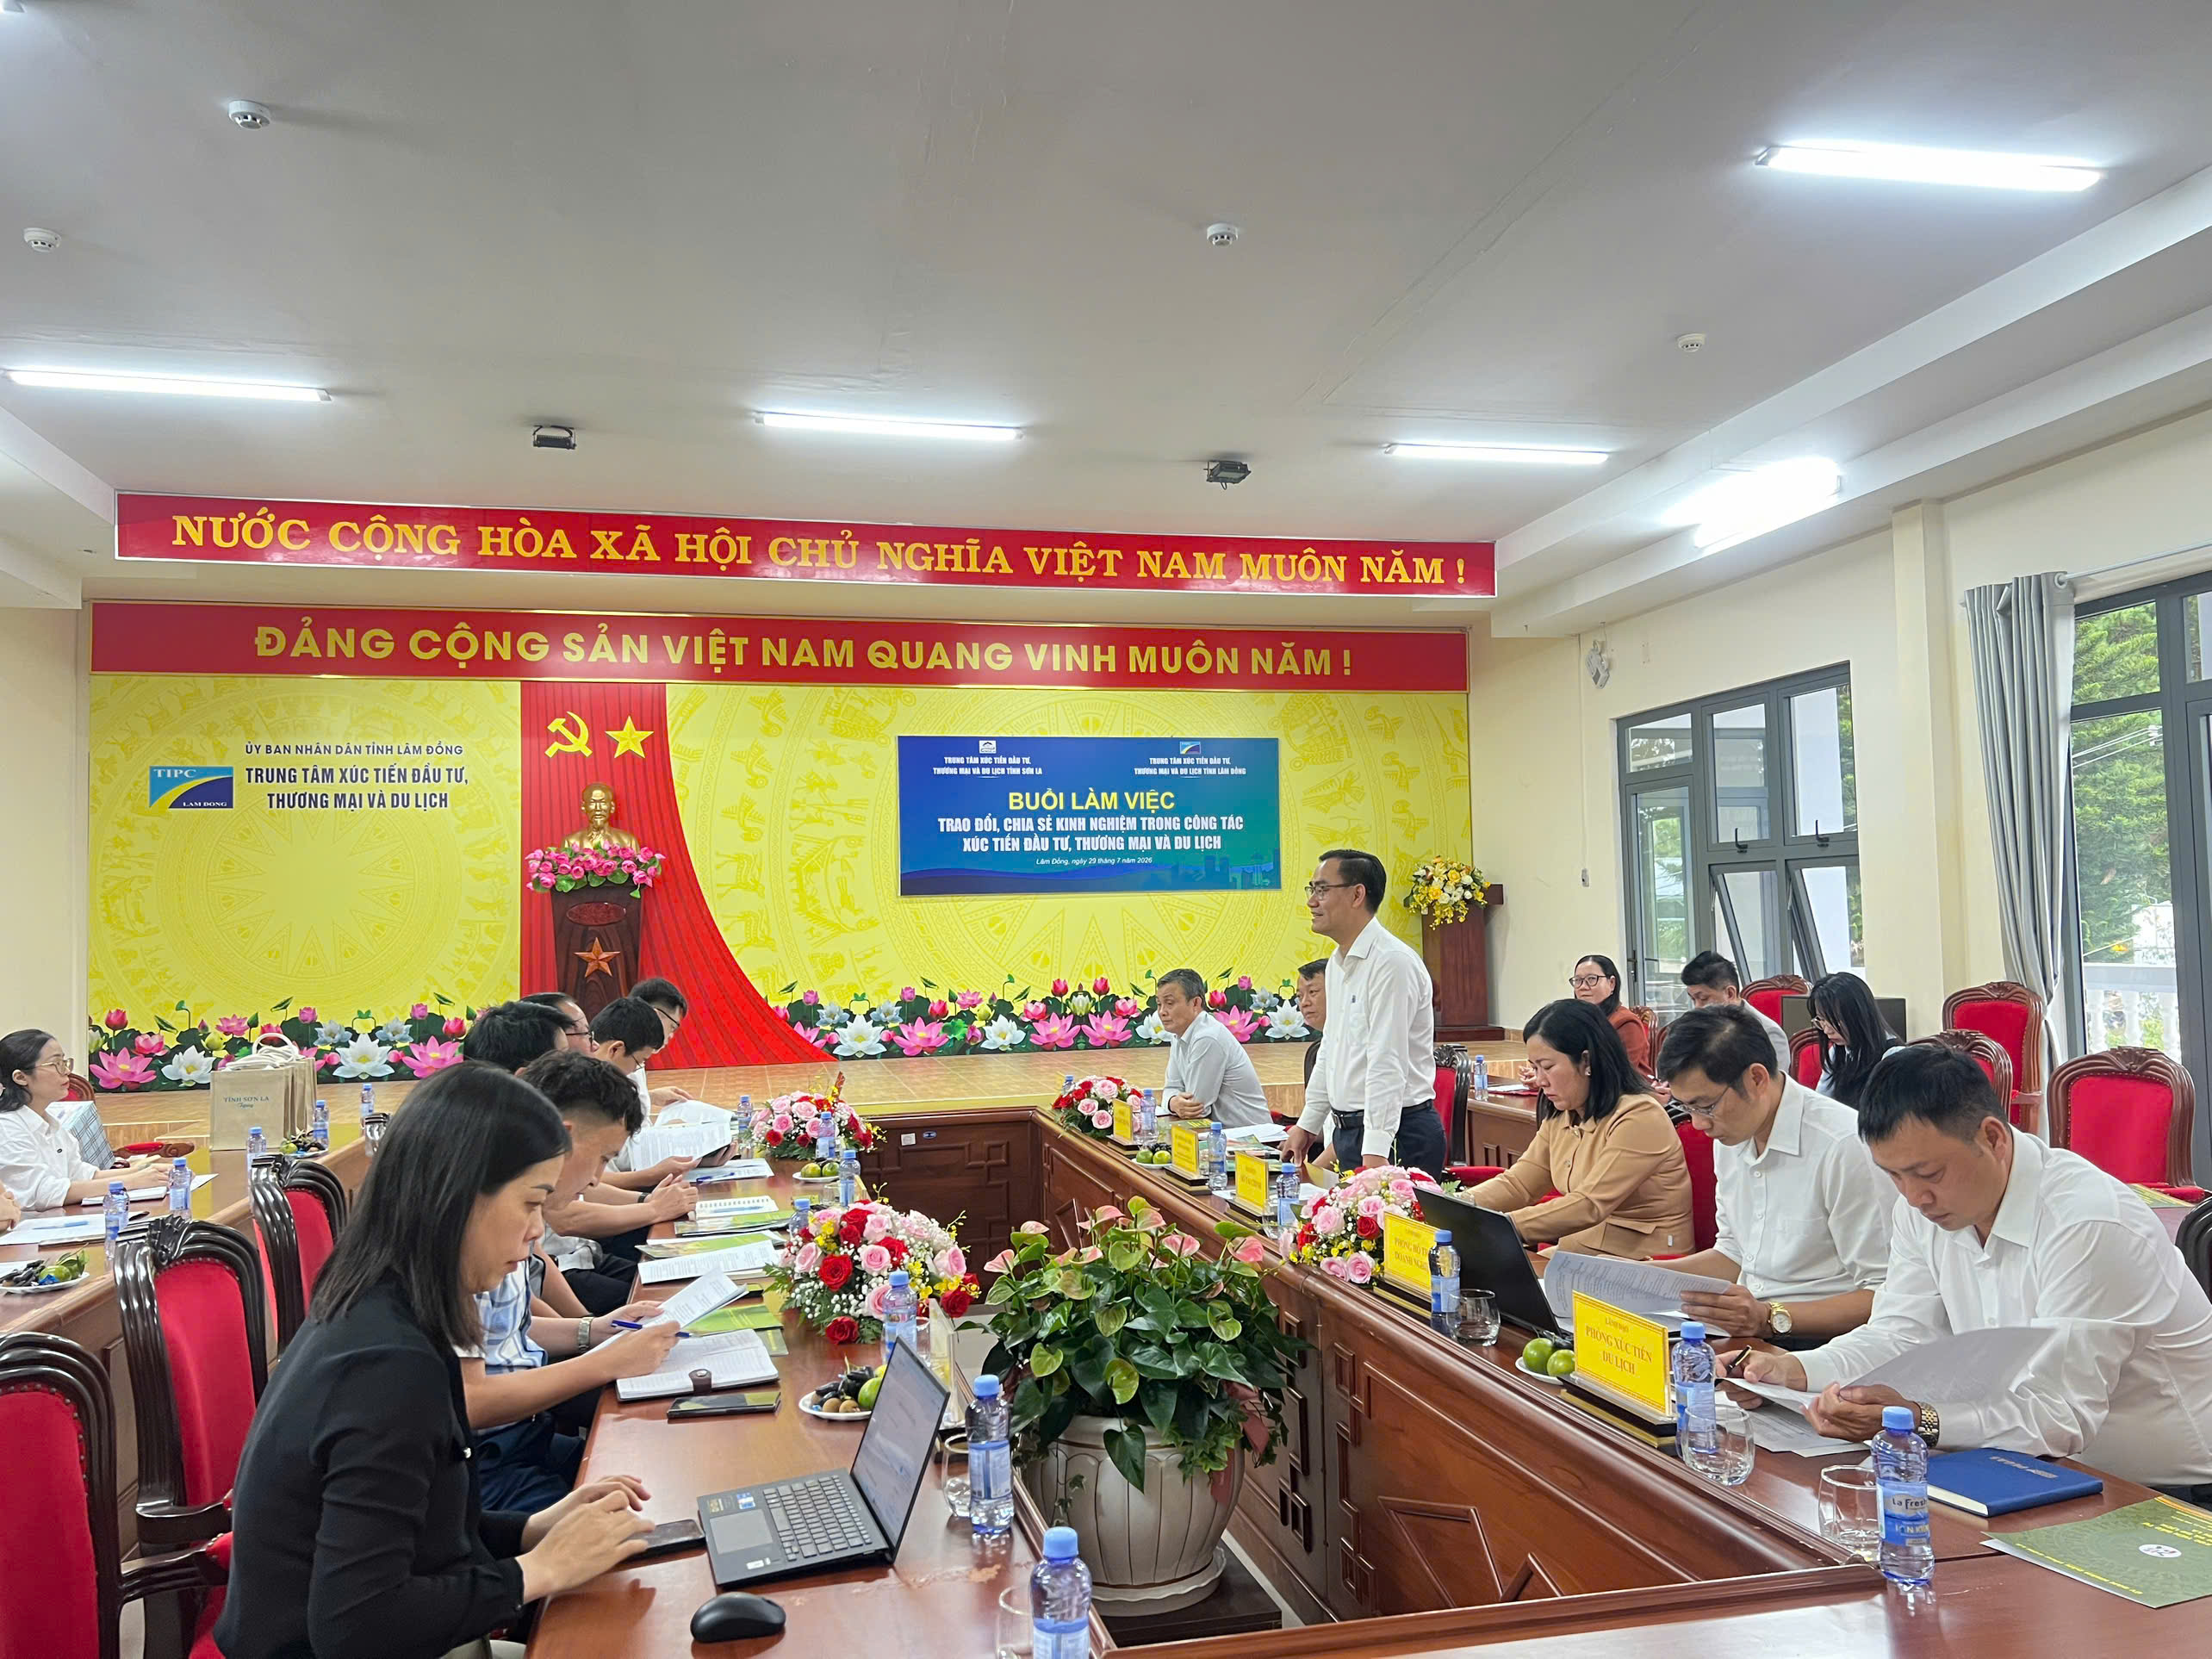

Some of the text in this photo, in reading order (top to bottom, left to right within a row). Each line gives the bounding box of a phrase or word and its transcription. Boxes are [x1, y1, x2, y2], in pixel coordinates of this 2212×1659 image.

[172, 506, 1466, 584] NƯỚC CỘNG HÒA XÃ HỘI CHỦ NGHĨA VIỆT NAM MUÔN NĂM !
[255, 617, 1351, 675] ĐẢNG CỘNG SẢN VIỆT NAM QUANG VINH MUÔN NĂM !
[245, 741, 463, 755] ỦY BAN NHÂN DÂN TỈNH LÂM ĐỒNG
[153, 768, 196, 779] TIPC
[245, 762, 469, 786] TRUNG TÂM XÚC TIẾN ĐẦU TƯ,
[267, 790, 449, 811] THƯƠNG MẠI VÀ DU LỊCH
[1009, 787, 1175, 814] BUỔI LÀM VIỆC
[938, 813, 1244, 833] TRAO ĐỔI, CHIA SẺ KINH NGHIỆM TRONG CÔNG TÁC
[963, 833, 1221, 852] XÚC TIẾN ĐẦU TƯ, THƯƠNG MẠI VÀ DU LỊCH
[1586, 1326, 1652, 1363] PHÒNG XÚC TIẾN
[1603, 1351, 1635, 1375] DU LỊCH
